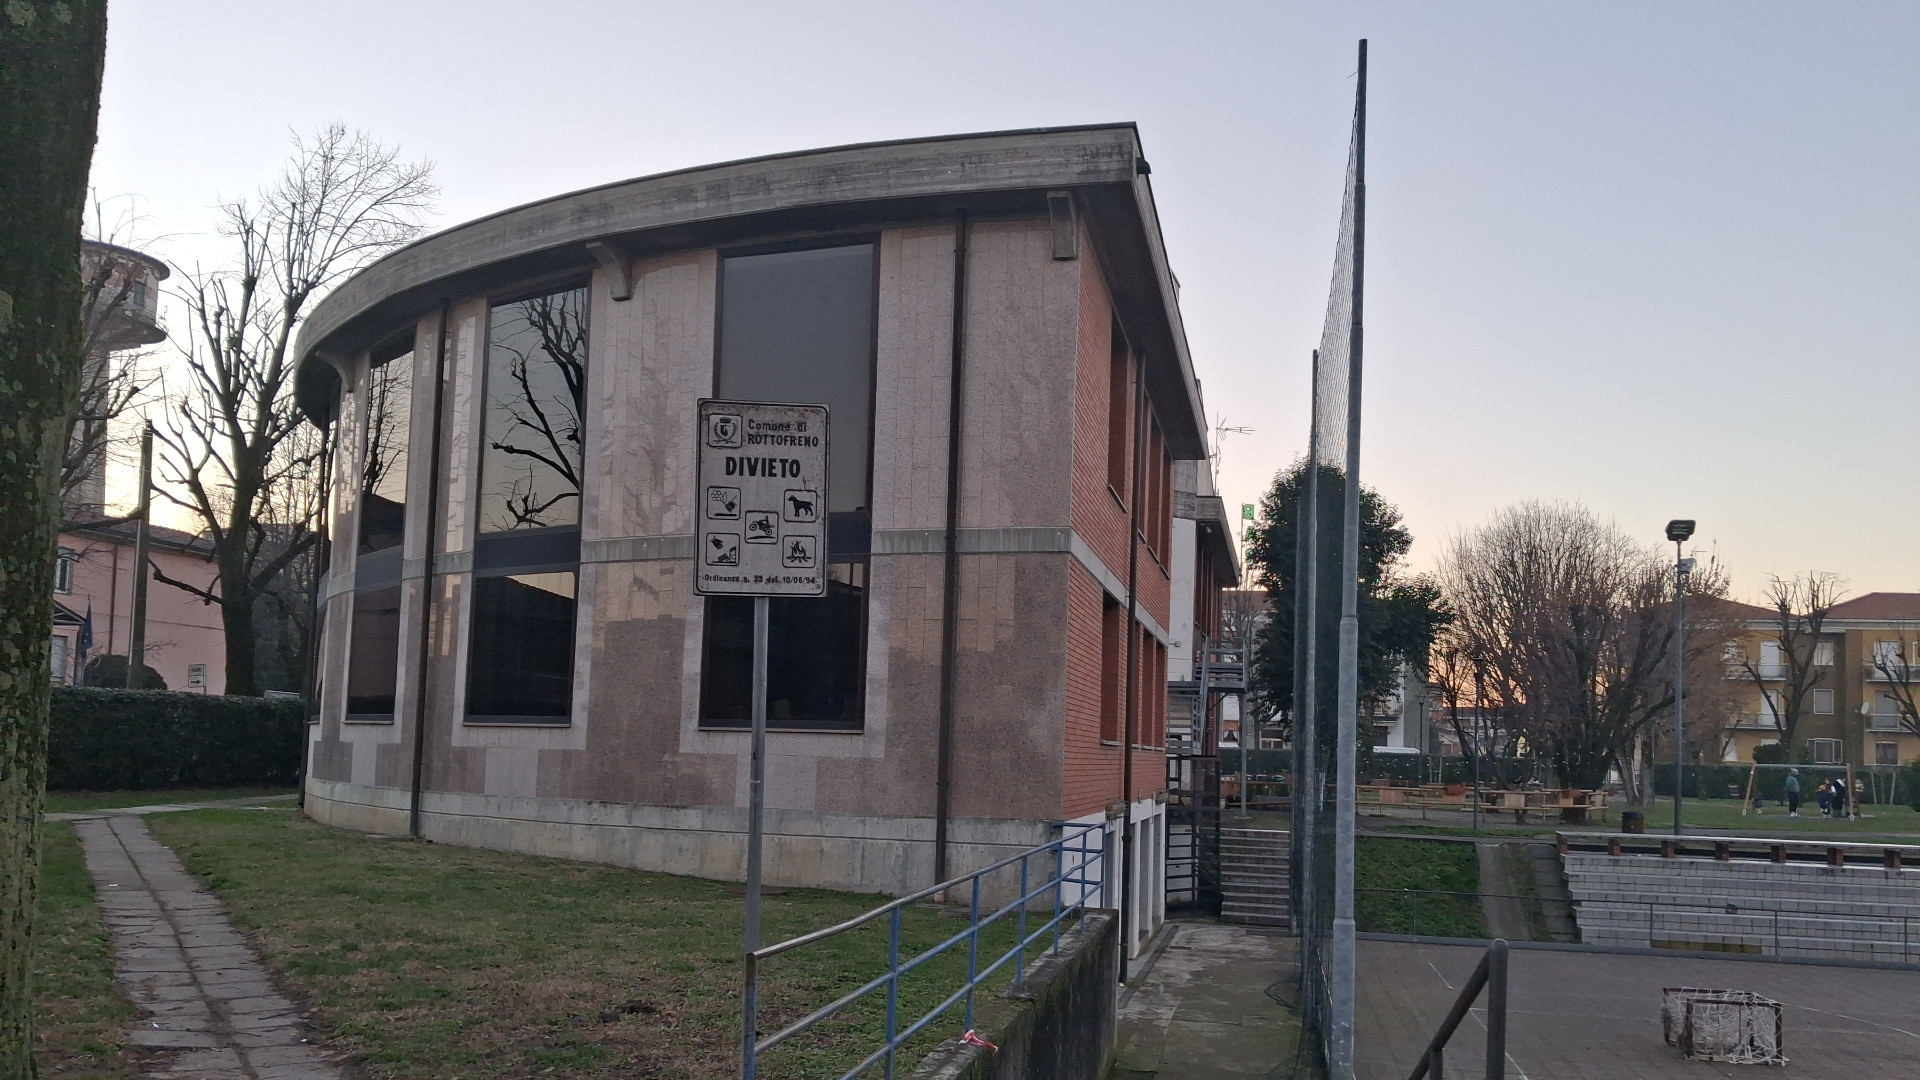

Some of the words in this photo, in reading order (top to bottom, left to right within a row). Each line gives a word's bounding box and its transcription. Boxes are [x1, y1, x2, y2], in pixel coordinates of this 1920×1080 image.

[748, 419, 791, 432] Comune
[797, 422, 807, 433] di
[747, 433, 819, 447] ROTTOFRENO
[725, 456, 801, 478] DIVIETO
